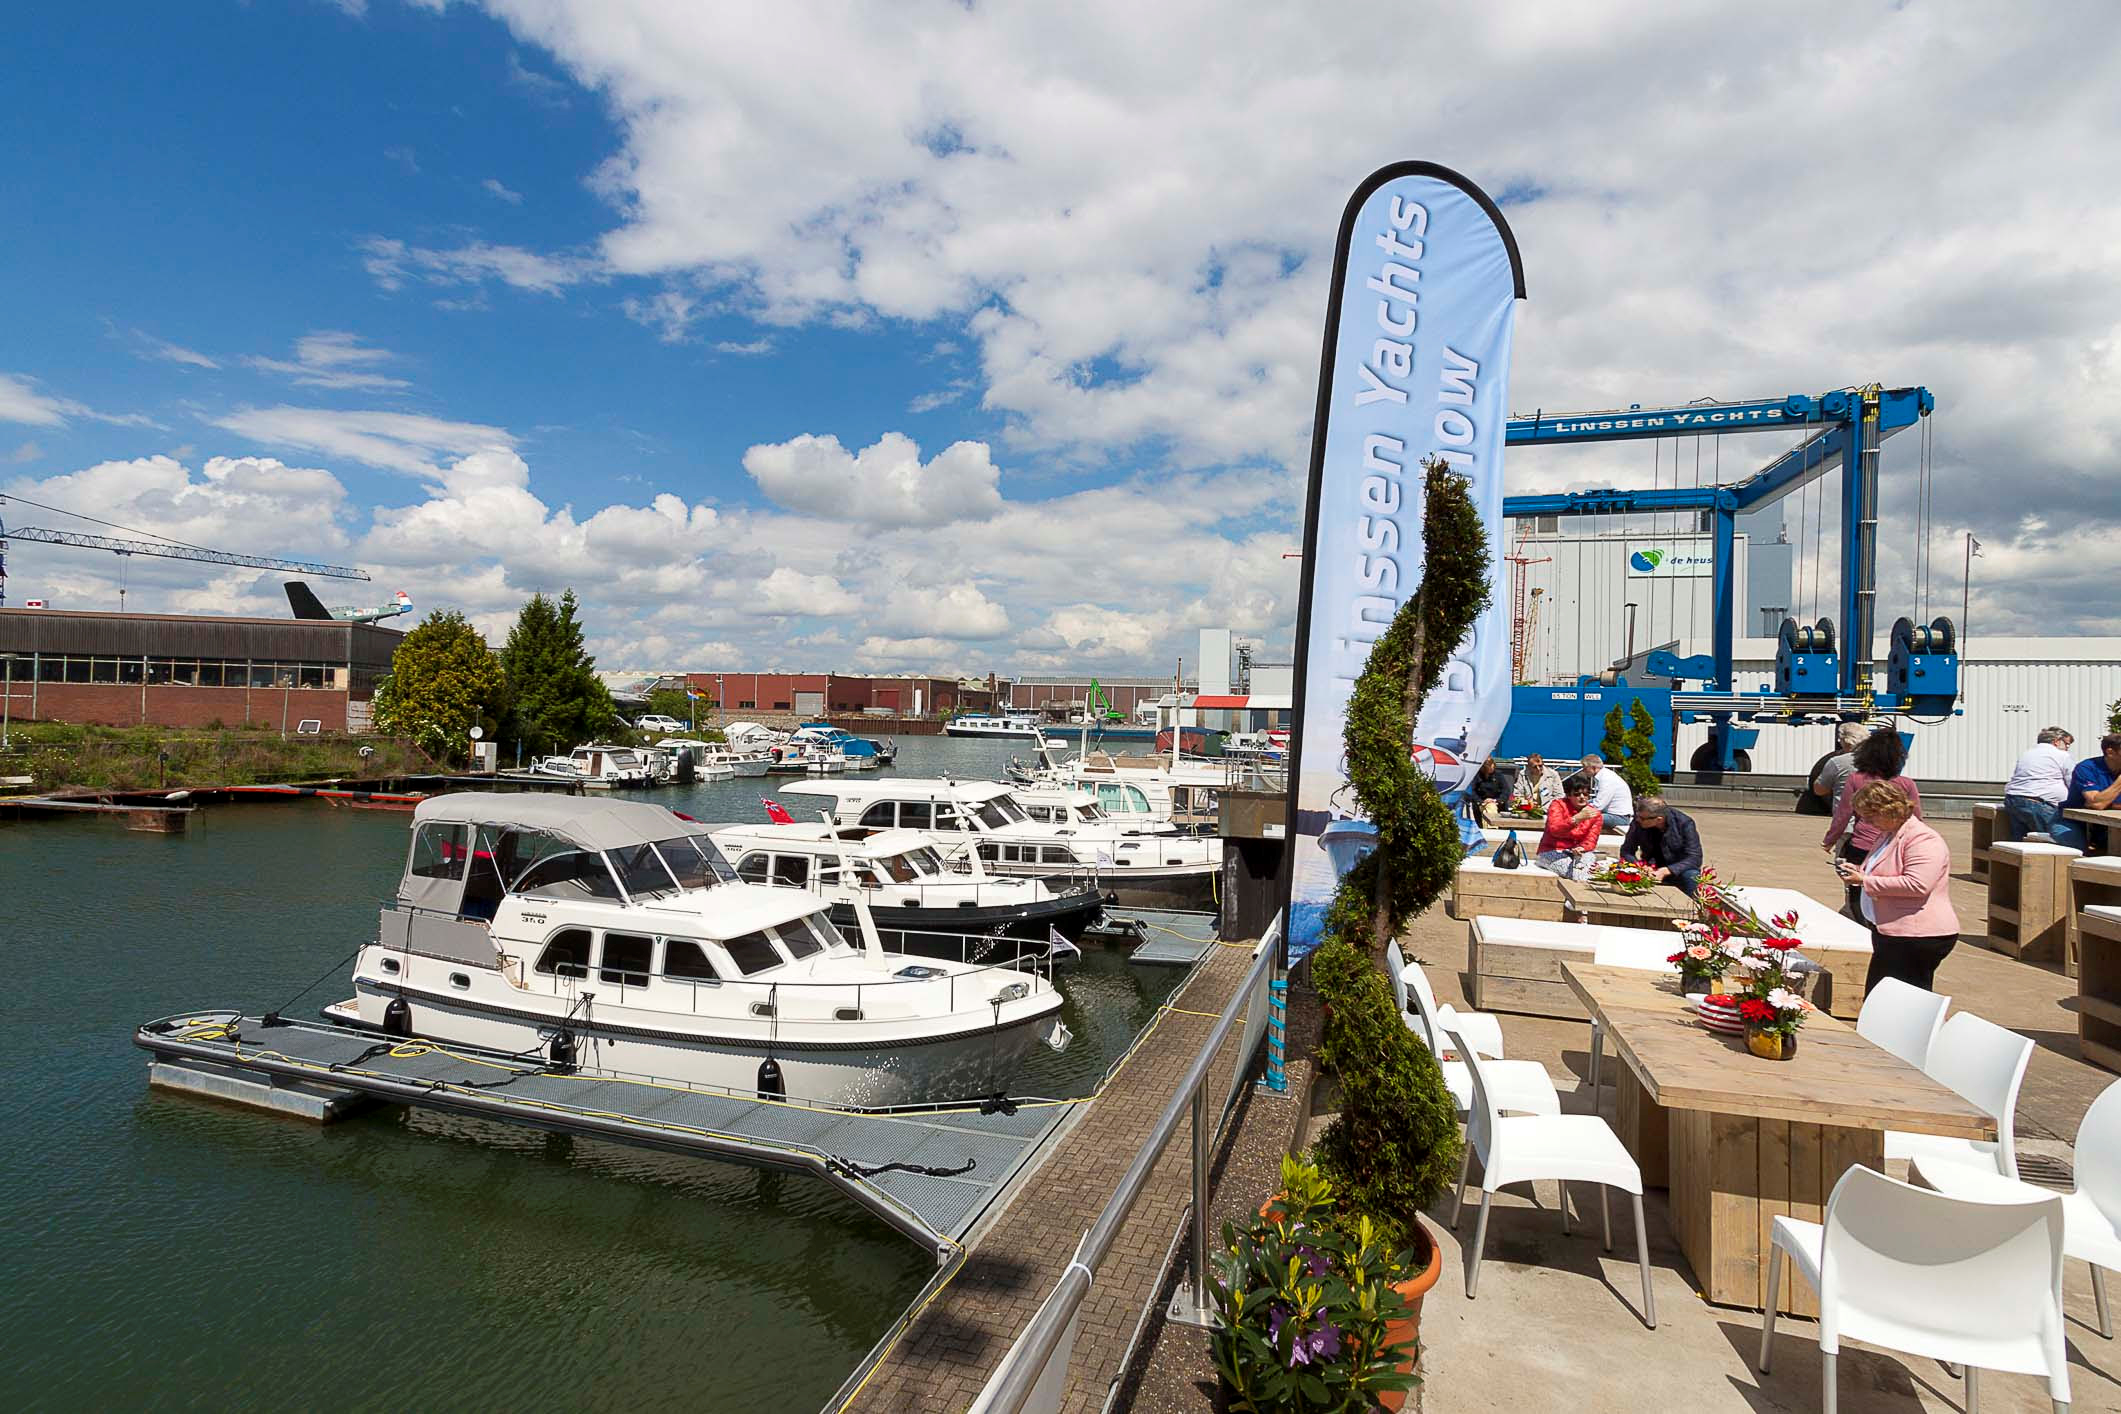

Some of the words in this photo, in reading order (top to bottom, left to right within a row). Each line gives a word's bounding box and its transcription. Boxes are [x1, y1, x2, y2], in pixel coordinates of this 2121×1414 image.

[1354, 196, 1429, 407] Yachts
[1556, 418, 1664, 433] LINSSEN
[1673, 409, 1783, 425] YACHTS
[1670, 557, 1683, 565] de
[1797, 657, 1805, 665] 2
[1825, 657, 1832, 665] 4
[1914, 657, 1921, 665] 3
[1943, 657, 1950, 665] 1
